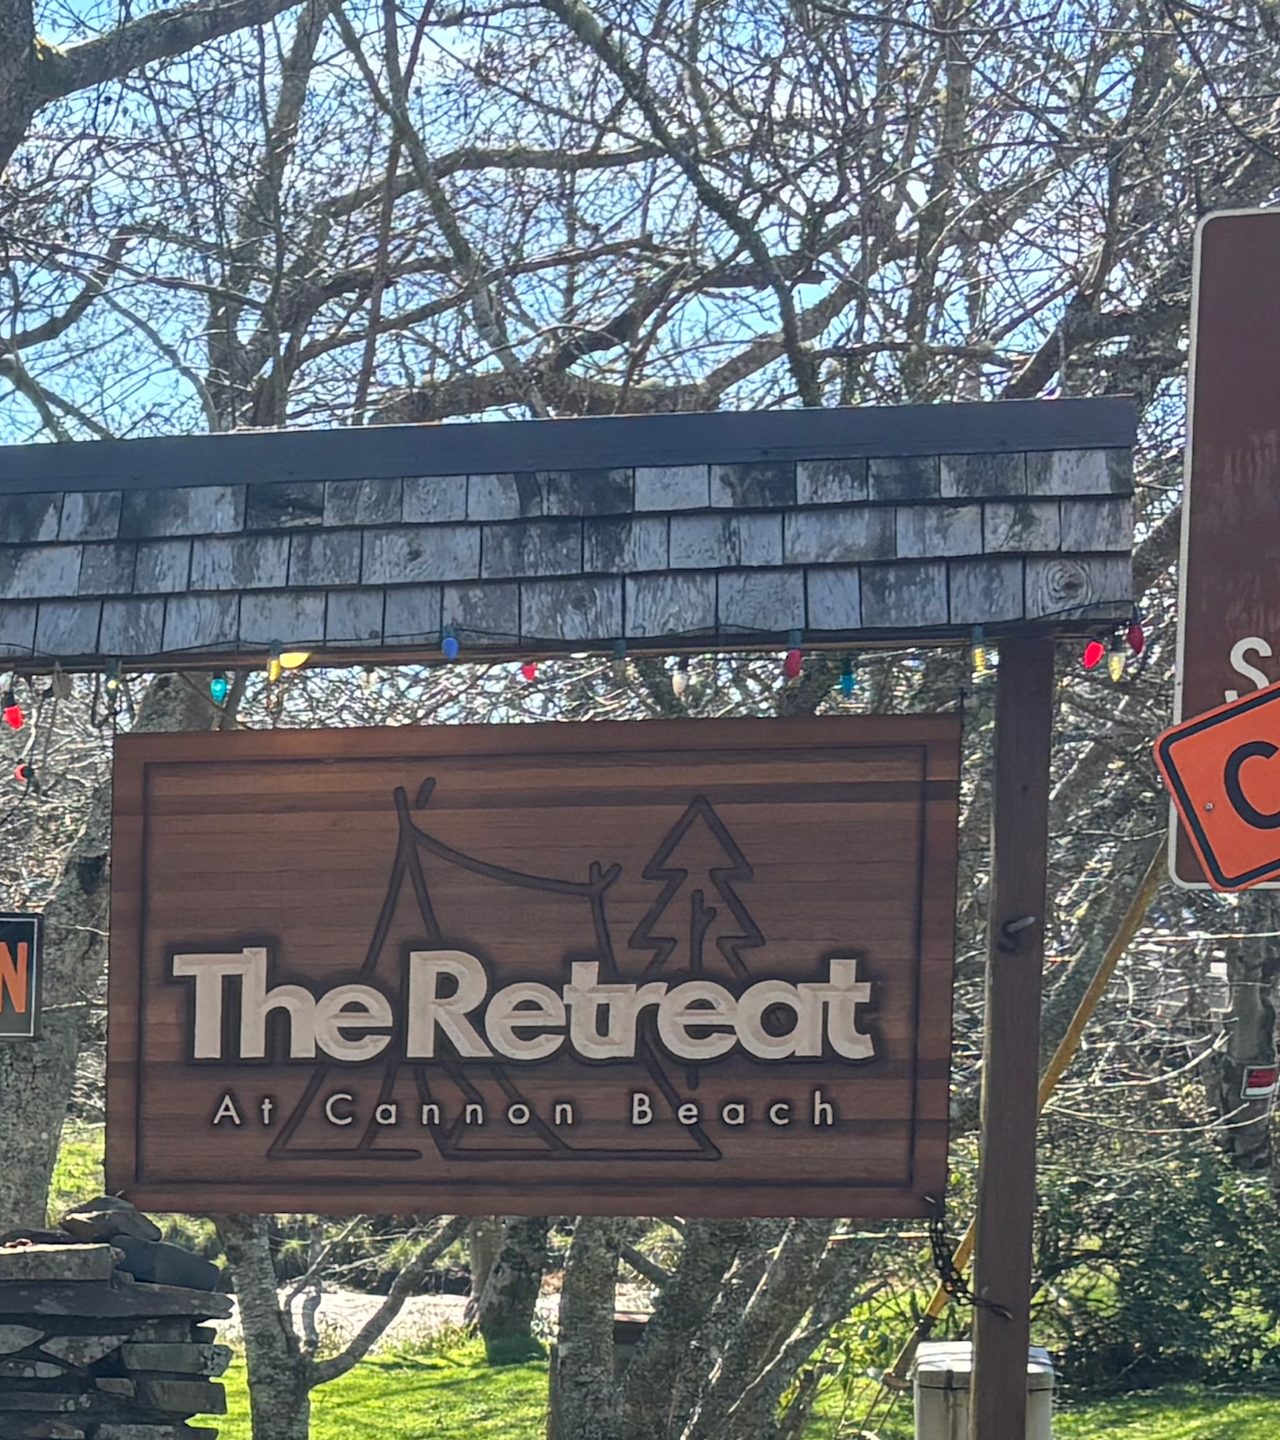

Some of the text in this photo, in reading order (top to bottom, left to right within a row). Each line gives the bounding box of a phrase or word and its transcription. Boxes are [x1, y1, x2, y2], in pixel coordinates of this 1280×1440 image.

[172, 946, 876, 1062] The Retreat
[213, 1090, 835, 1126] At Cannon Beach
